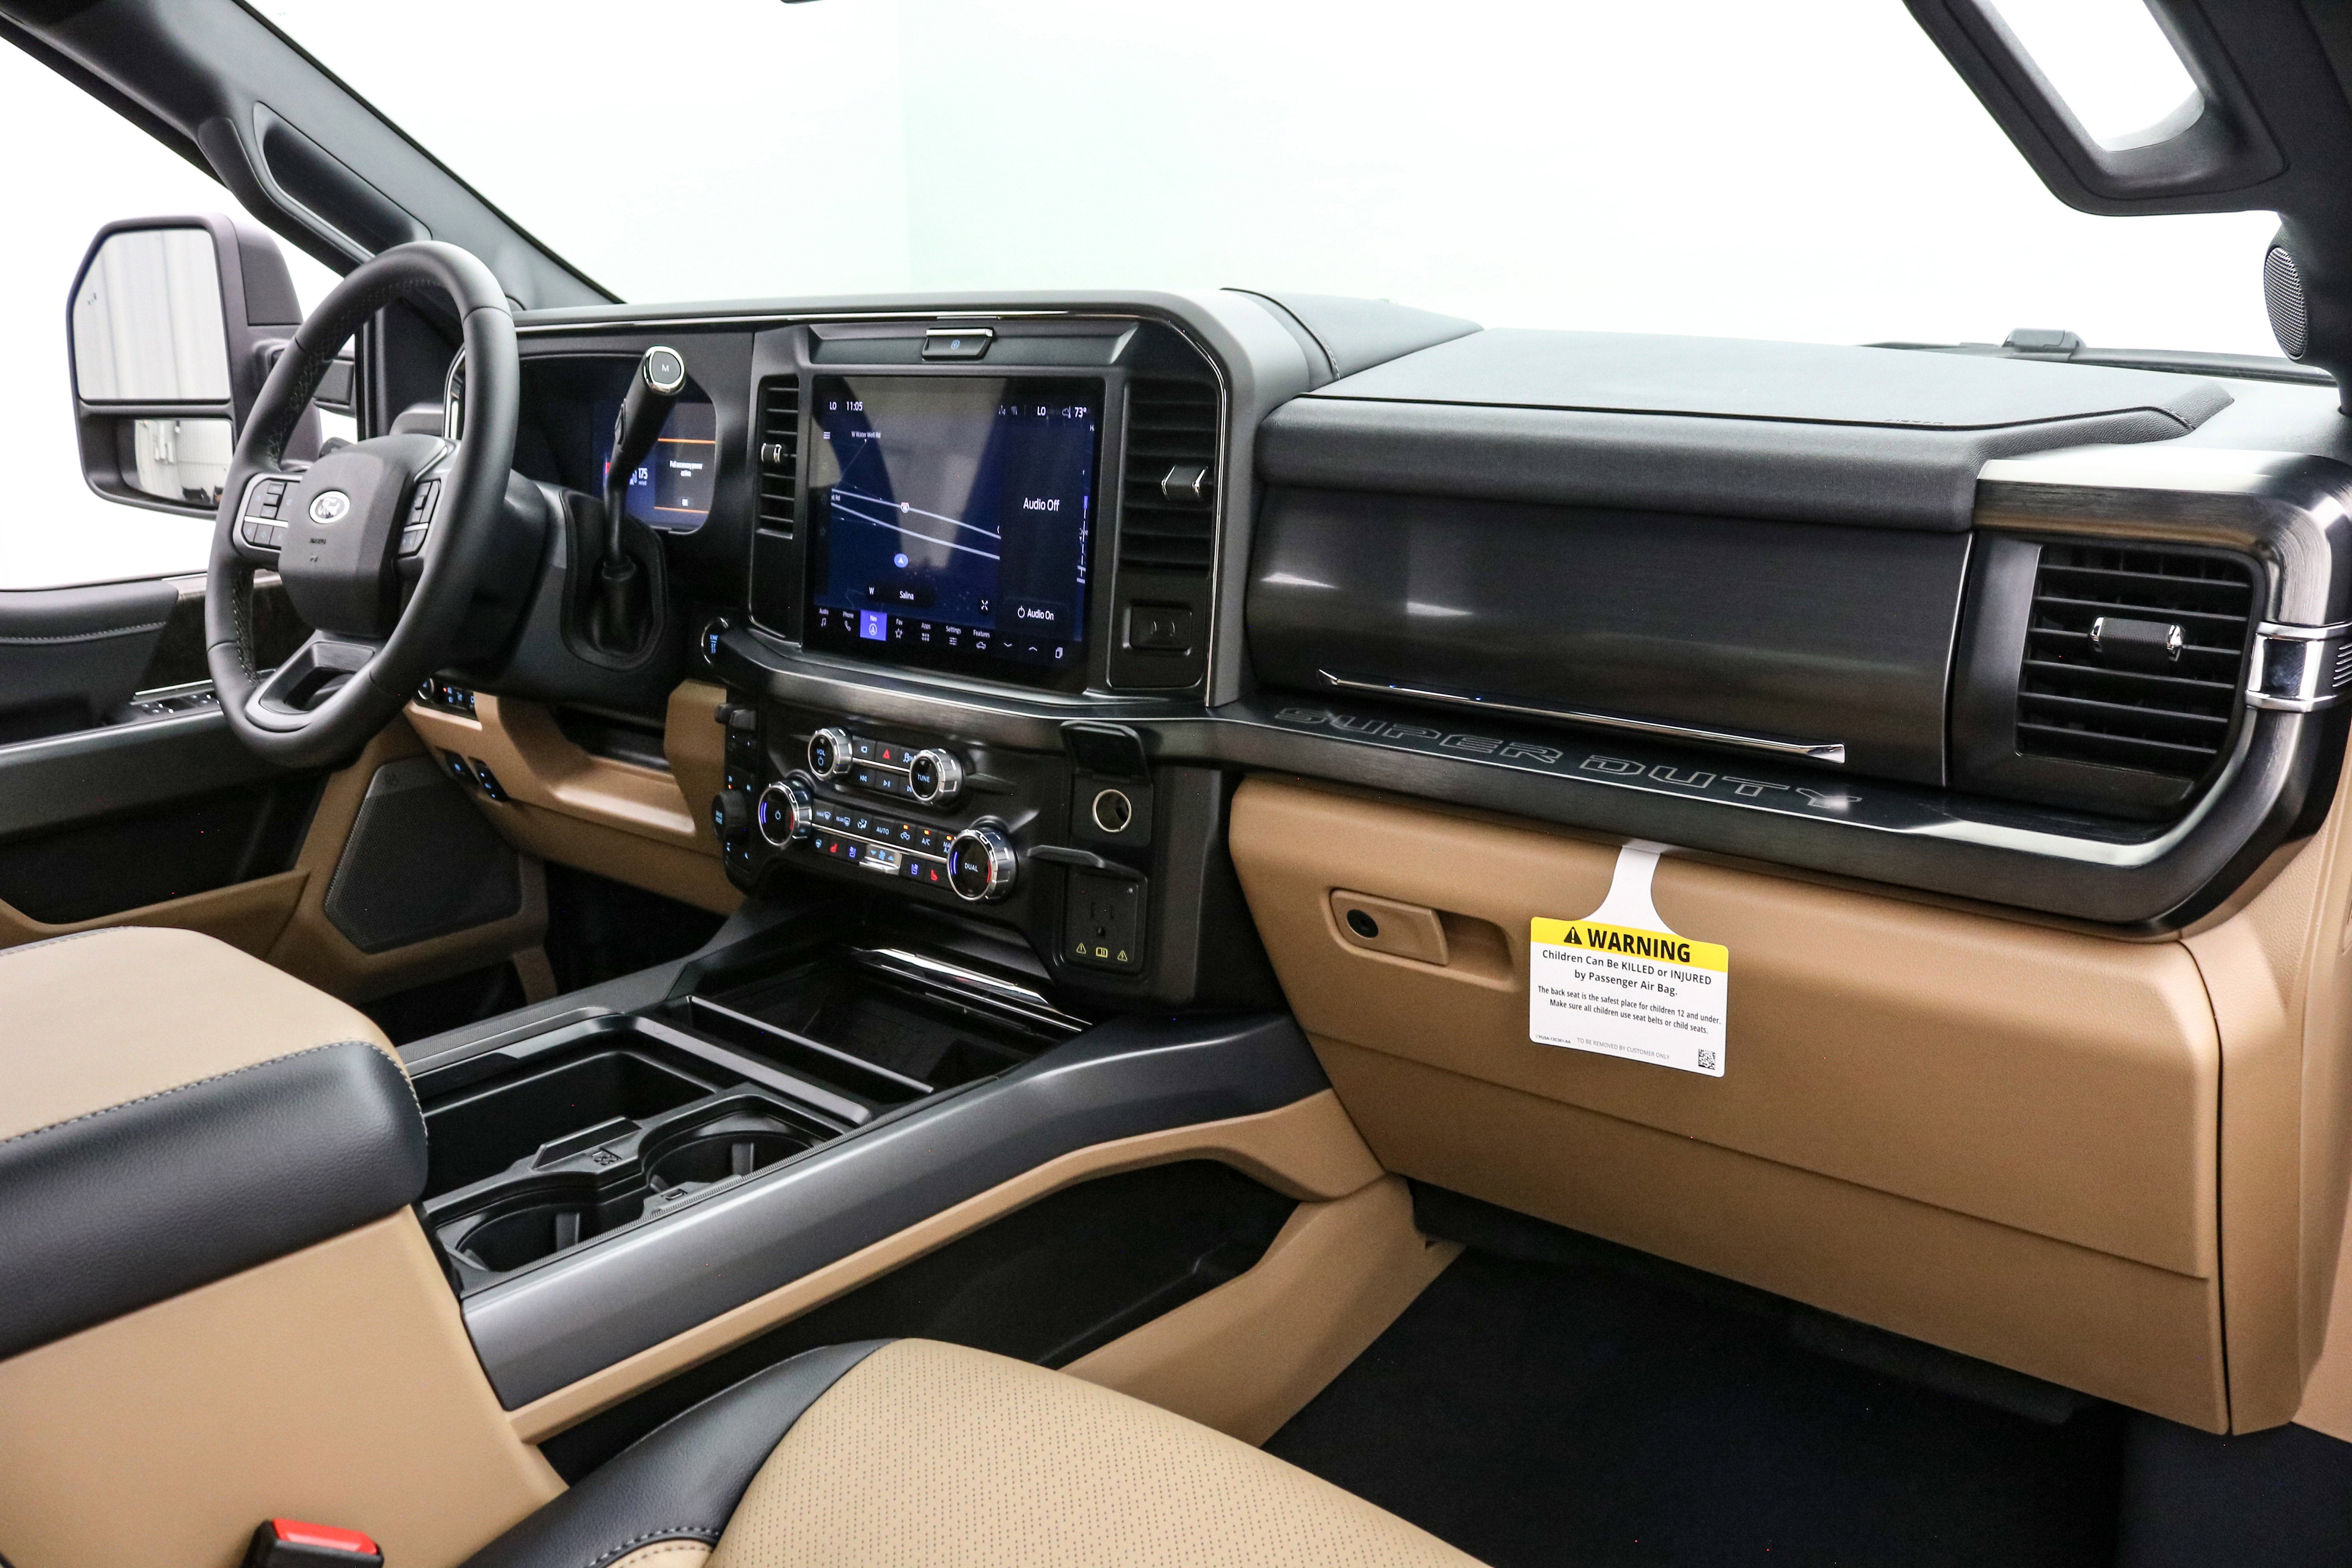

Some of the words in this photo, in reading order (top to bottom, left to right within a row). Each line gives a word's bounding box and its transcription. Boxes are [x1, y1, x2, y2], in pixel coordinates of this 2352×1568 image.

[662, 364, 669, 372] M
[829, 401, 837, 410] LO
[846, 401, 863, 411] 11:05
[1037, 406, 1046, 416] LO
[638, 468, 648, 479] 175
[1023, 497, 1046, 510] Audio
[1047, 499, 1060, 511] Off
[900, 590, 914, 600] Salina
[1027, 608, 1044, 619] Audio
[1045, 610, 1054, 621] On
[946, 626, 961, 635] Settings
[973, 629, 990, 638] Features
[1274, 707, 1564, 764] SUPER
[1579, 754, 1862, 809] DUTY
[918, 774, 930, 783] TUNE
[876, 826, 889, 835] AUTO
[921, 837, 931, 846] A/C
[964, 862, 978, 872] DUAL
[1587, 928, 1690, 963] WARNING
[1542, 949, 1583, 963] Children
[1586, 956, 1604, 966] Can
[1607, 959, 1619, 969] Be
[1622, 961, 1654, 974] KILLED
[1671, 970, 1711, 984] INJURED
[1575, 969, 1586, 981] by
[1589, 972, 1638, 988] Passenger
[1640, 980, 1655, 991] Air
[1657, 983, 1678, 997] Bag.
[1538, 985, 1549, 994] The
[1551, 987, 1565, 996] back
[1589, 993, 1599, 1002] the
[1601, 996, 1619, 1005] safest
[1621, 999, 1637, 1008] place
[1639, 1002, 1648, 1010] for
[1650, 1004, 1675, 1015] children
[1677, 1009, 1684, 1017] 12
[1700, 1016, 1721, 1025] under.
[1550, 999, 1567, 1008] Make
[1593, 1006, 1618, 1016] children
[1648, 1015, 1663, 1025] belts
[1674, 1021, 1688, 1030] child
[1690, 1026, 1708, 1034] seats.
[1593, 1040, 1618, 1049] REMOVED
[1626, 1047, 1655, 1057] CUSTOMER
